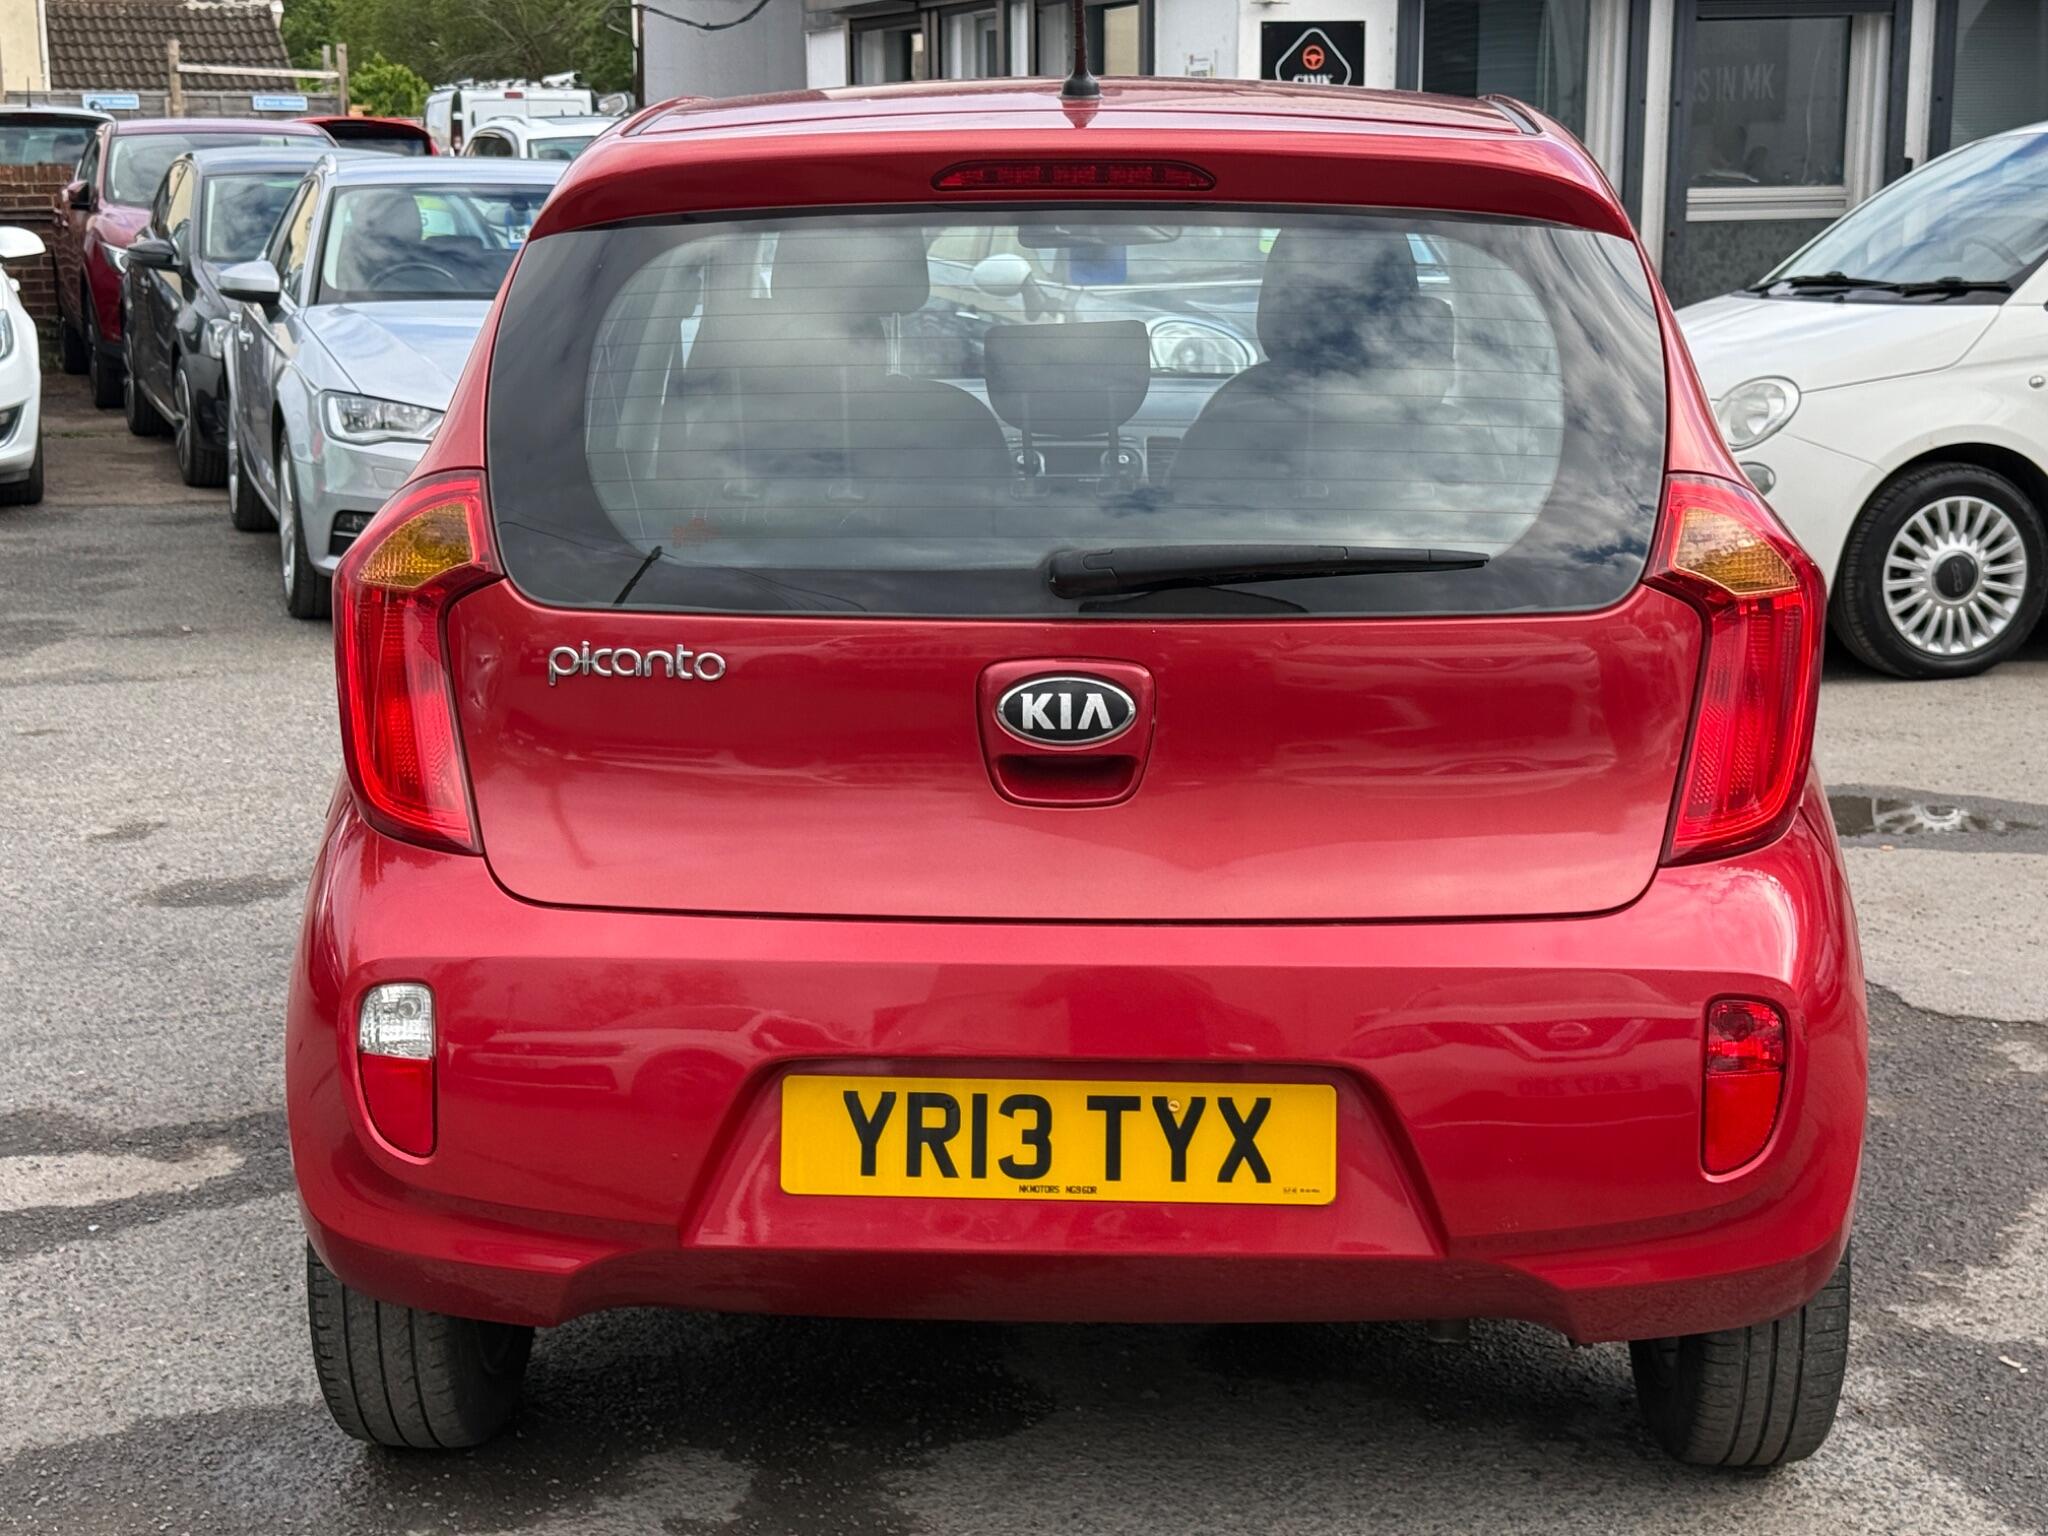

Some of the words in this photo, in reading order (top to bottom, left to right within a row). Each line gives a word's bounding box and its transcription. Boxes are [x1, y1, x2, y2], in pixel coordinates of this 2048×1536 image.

[1715, 65, 1737, 102] IN
[1742, 63, 1776, 102] MK
[548, 640, 727, 686] picanto
[1020, 691, 1112, 730] KIA
[843, 1090, 1053, 1180] YR13
[1086, 1094, 1272, 1184] TYX
